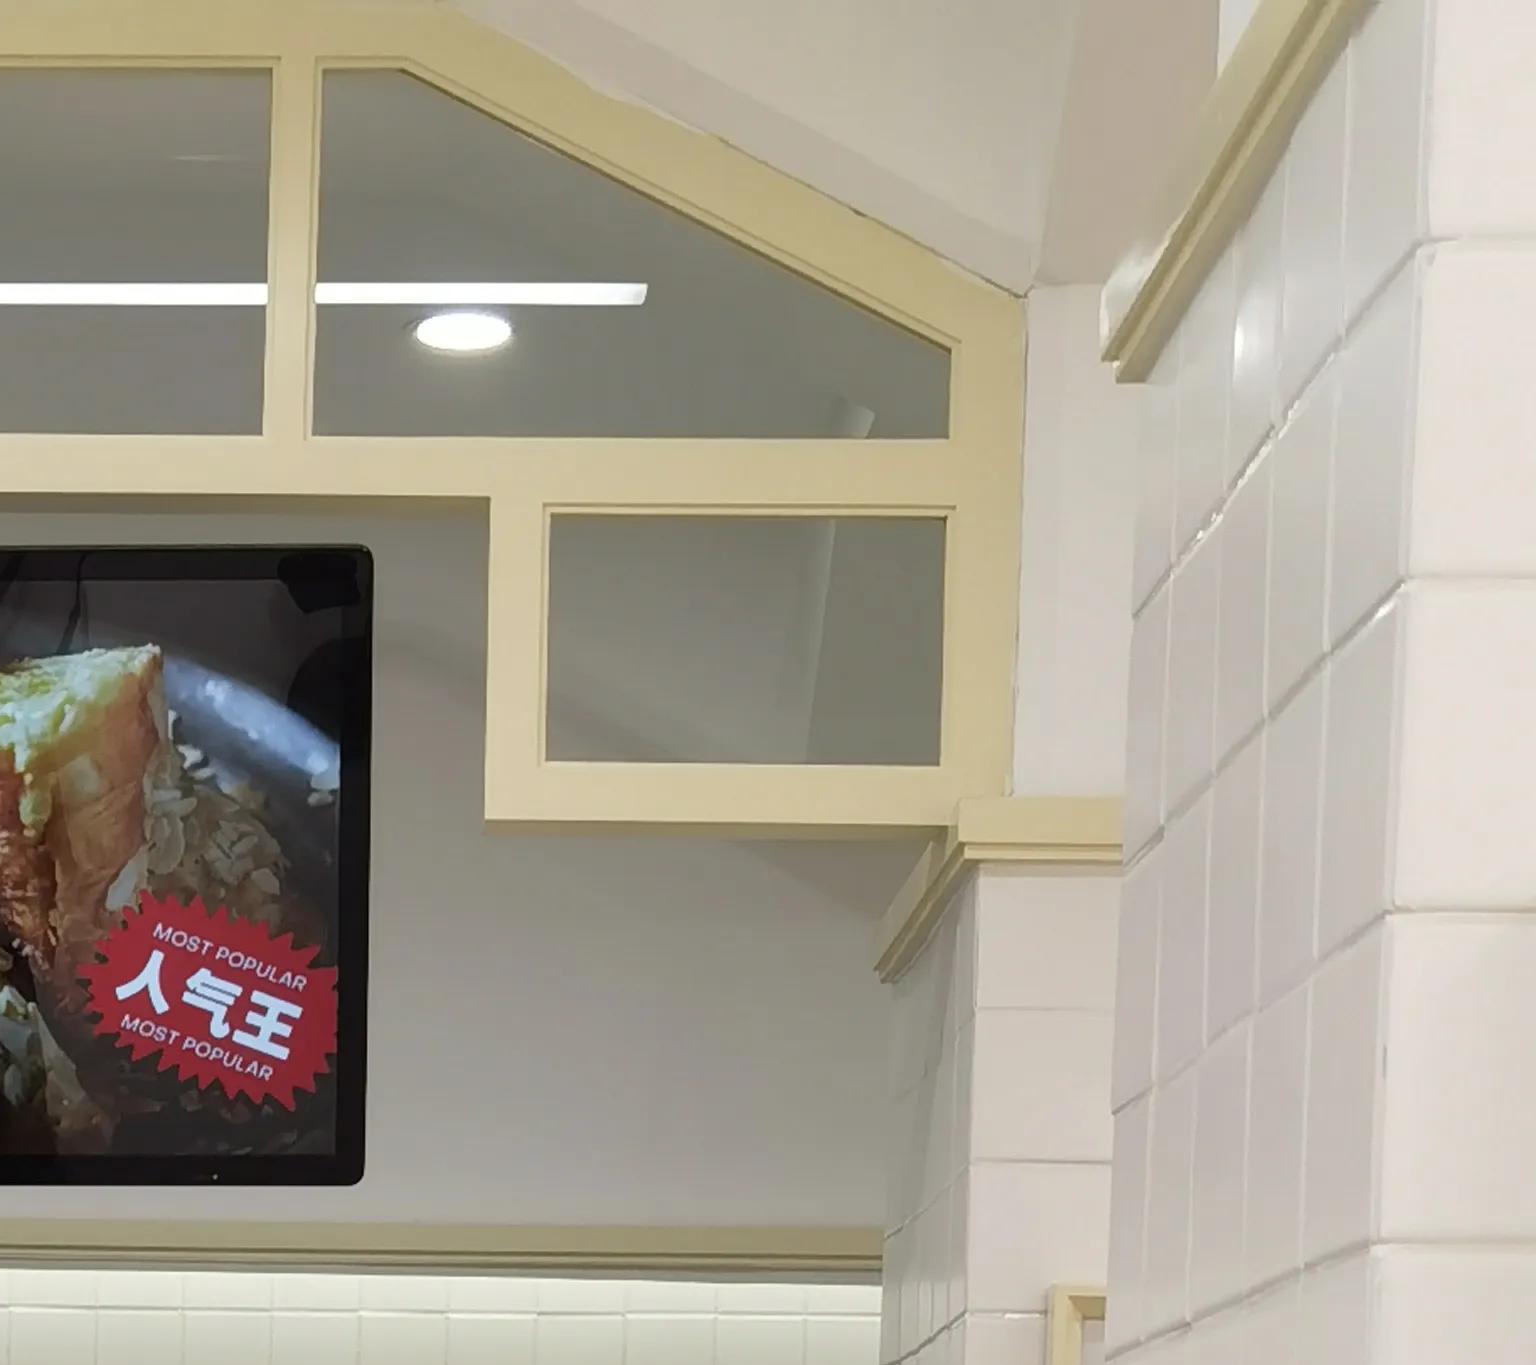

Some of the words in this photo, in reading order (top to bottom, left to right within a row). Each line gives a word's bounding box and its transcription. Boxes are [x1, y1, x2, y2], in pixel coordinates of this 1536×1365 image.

[152, 922, 213, 957] MOST
[215, 946, 307, 992] POPULAR
[115, 949, 303, 1061] 人气王
[120, 1013, 181, 1046] MOST
[182, 1036, 273, 1082] POPULAR
